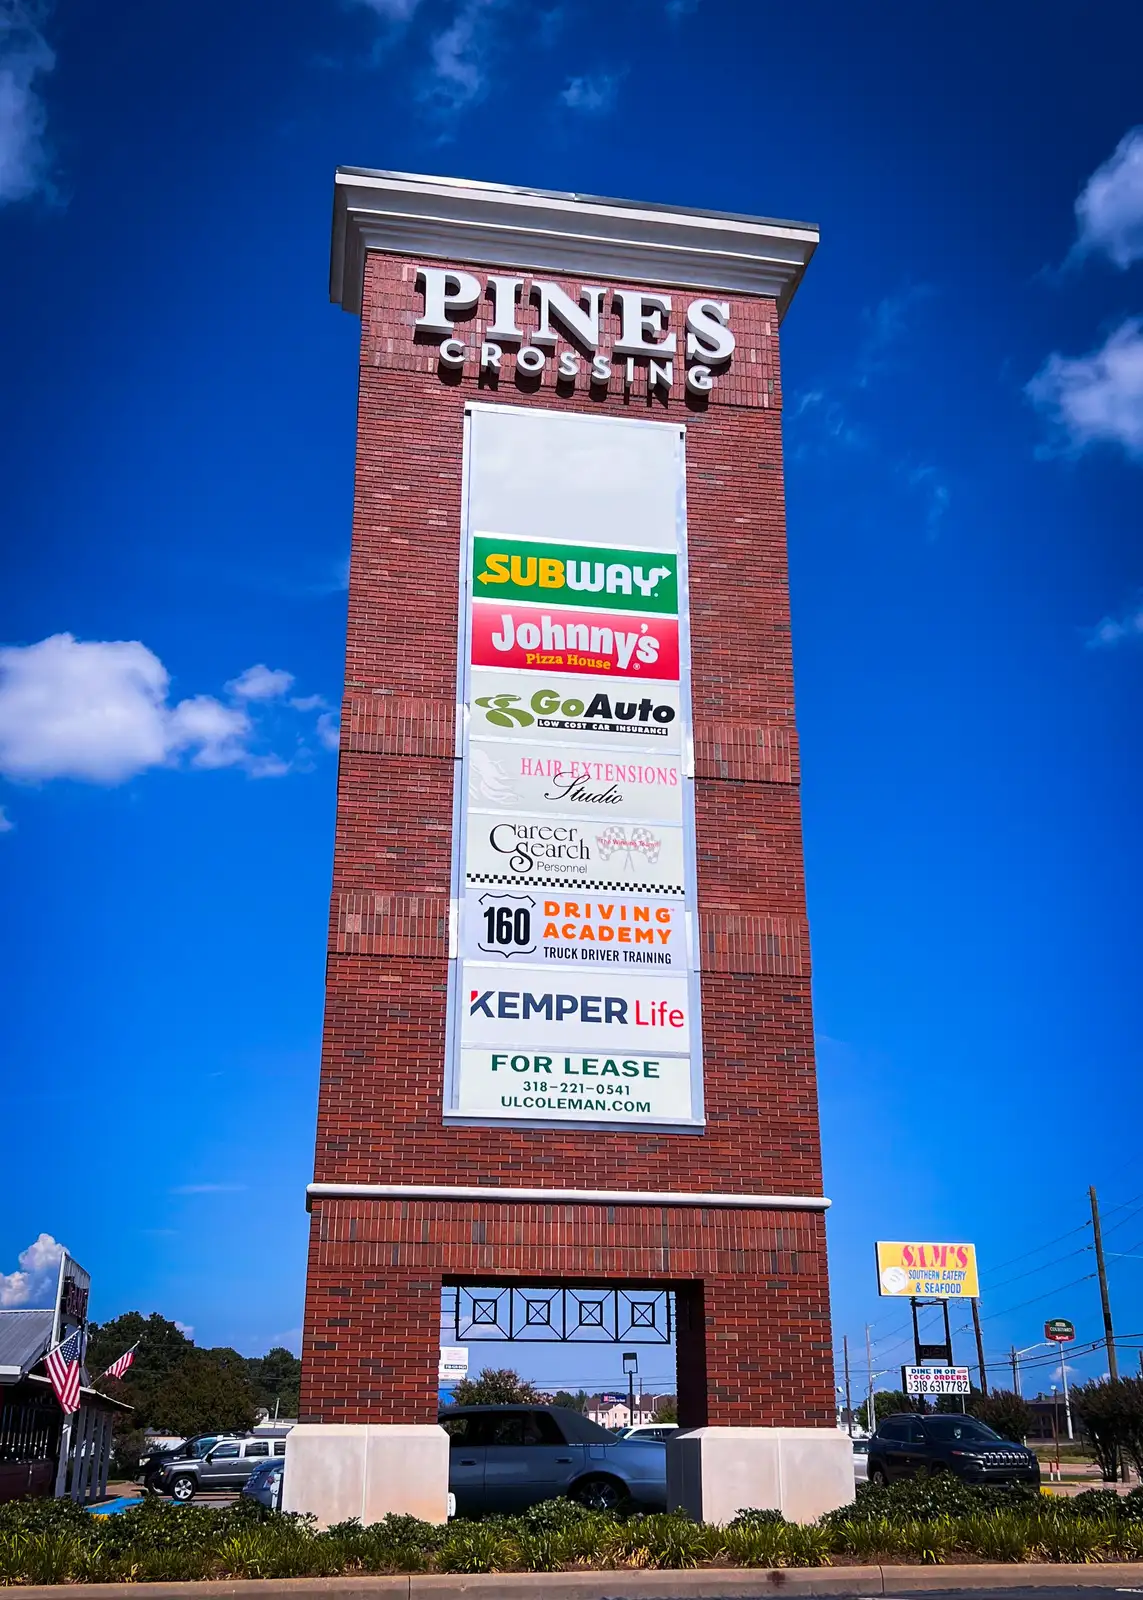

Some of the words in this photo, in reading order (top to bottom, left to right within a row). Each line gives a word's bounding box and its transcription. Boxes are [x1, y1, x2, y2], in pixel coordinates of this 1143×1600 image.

[416, 267, 736, 367] PINES
[439, 338, 714, 396] CROSSING
[477, 554, 672, 597] SUBWAY
[491, 614, 660, 670] Johnny's
[526, 653, 563, 665] Pizza
[567, 654, 611, 671] House
[530, 689, 676, 724] GoAuto
[539, 719, 560, 728] LOW
[564, 721, 587, 730] COST
[592, 723, 610, 731] CAR
[616, 725, 667, 735] INSURANCE
[521, 757, 564, 778] HAIR
[570, 761, 678, 786] EXTENSIONS
[544, 771, 623, 804] Studio
[489, 824, 578, 854] Career
[509, 838, 591, 873] Search
[536, 861, 588, 874] Personnel
[543, 900, 671, 923] DRIVING
[483, 906, 531, 946] 160
[542, 922, 671, 945] ACADEMY
[543, 946, 578, 960] TRUCK
[581, 948, 619, 962] DRIVER
[623, 950, 671, 964] TRAINING
[470, 990, 628, 1025] KEMPER
[635, 999, 684, 1028] Life
[491, 1054, 552, 1074] FOR
[564, 1057, 660, 1079] LEASE
[523, 1080, 630, 1096] 318-221-0541
[501, 1096, 651, 1113] ULCOLEMAN.COM
[901, 1245, 968, 1269] SAM'S
[908, 1269, 940, 1280] SOUTHERN
[942, 1270, 966, 1281] EATERY
[915, 1282, 921, 1293] &
[924, 1282, 961, 1294] SEAFOOD
[913, 1380, 928, 1393] 318
[929, 1380, 969, 1393] 6317782
